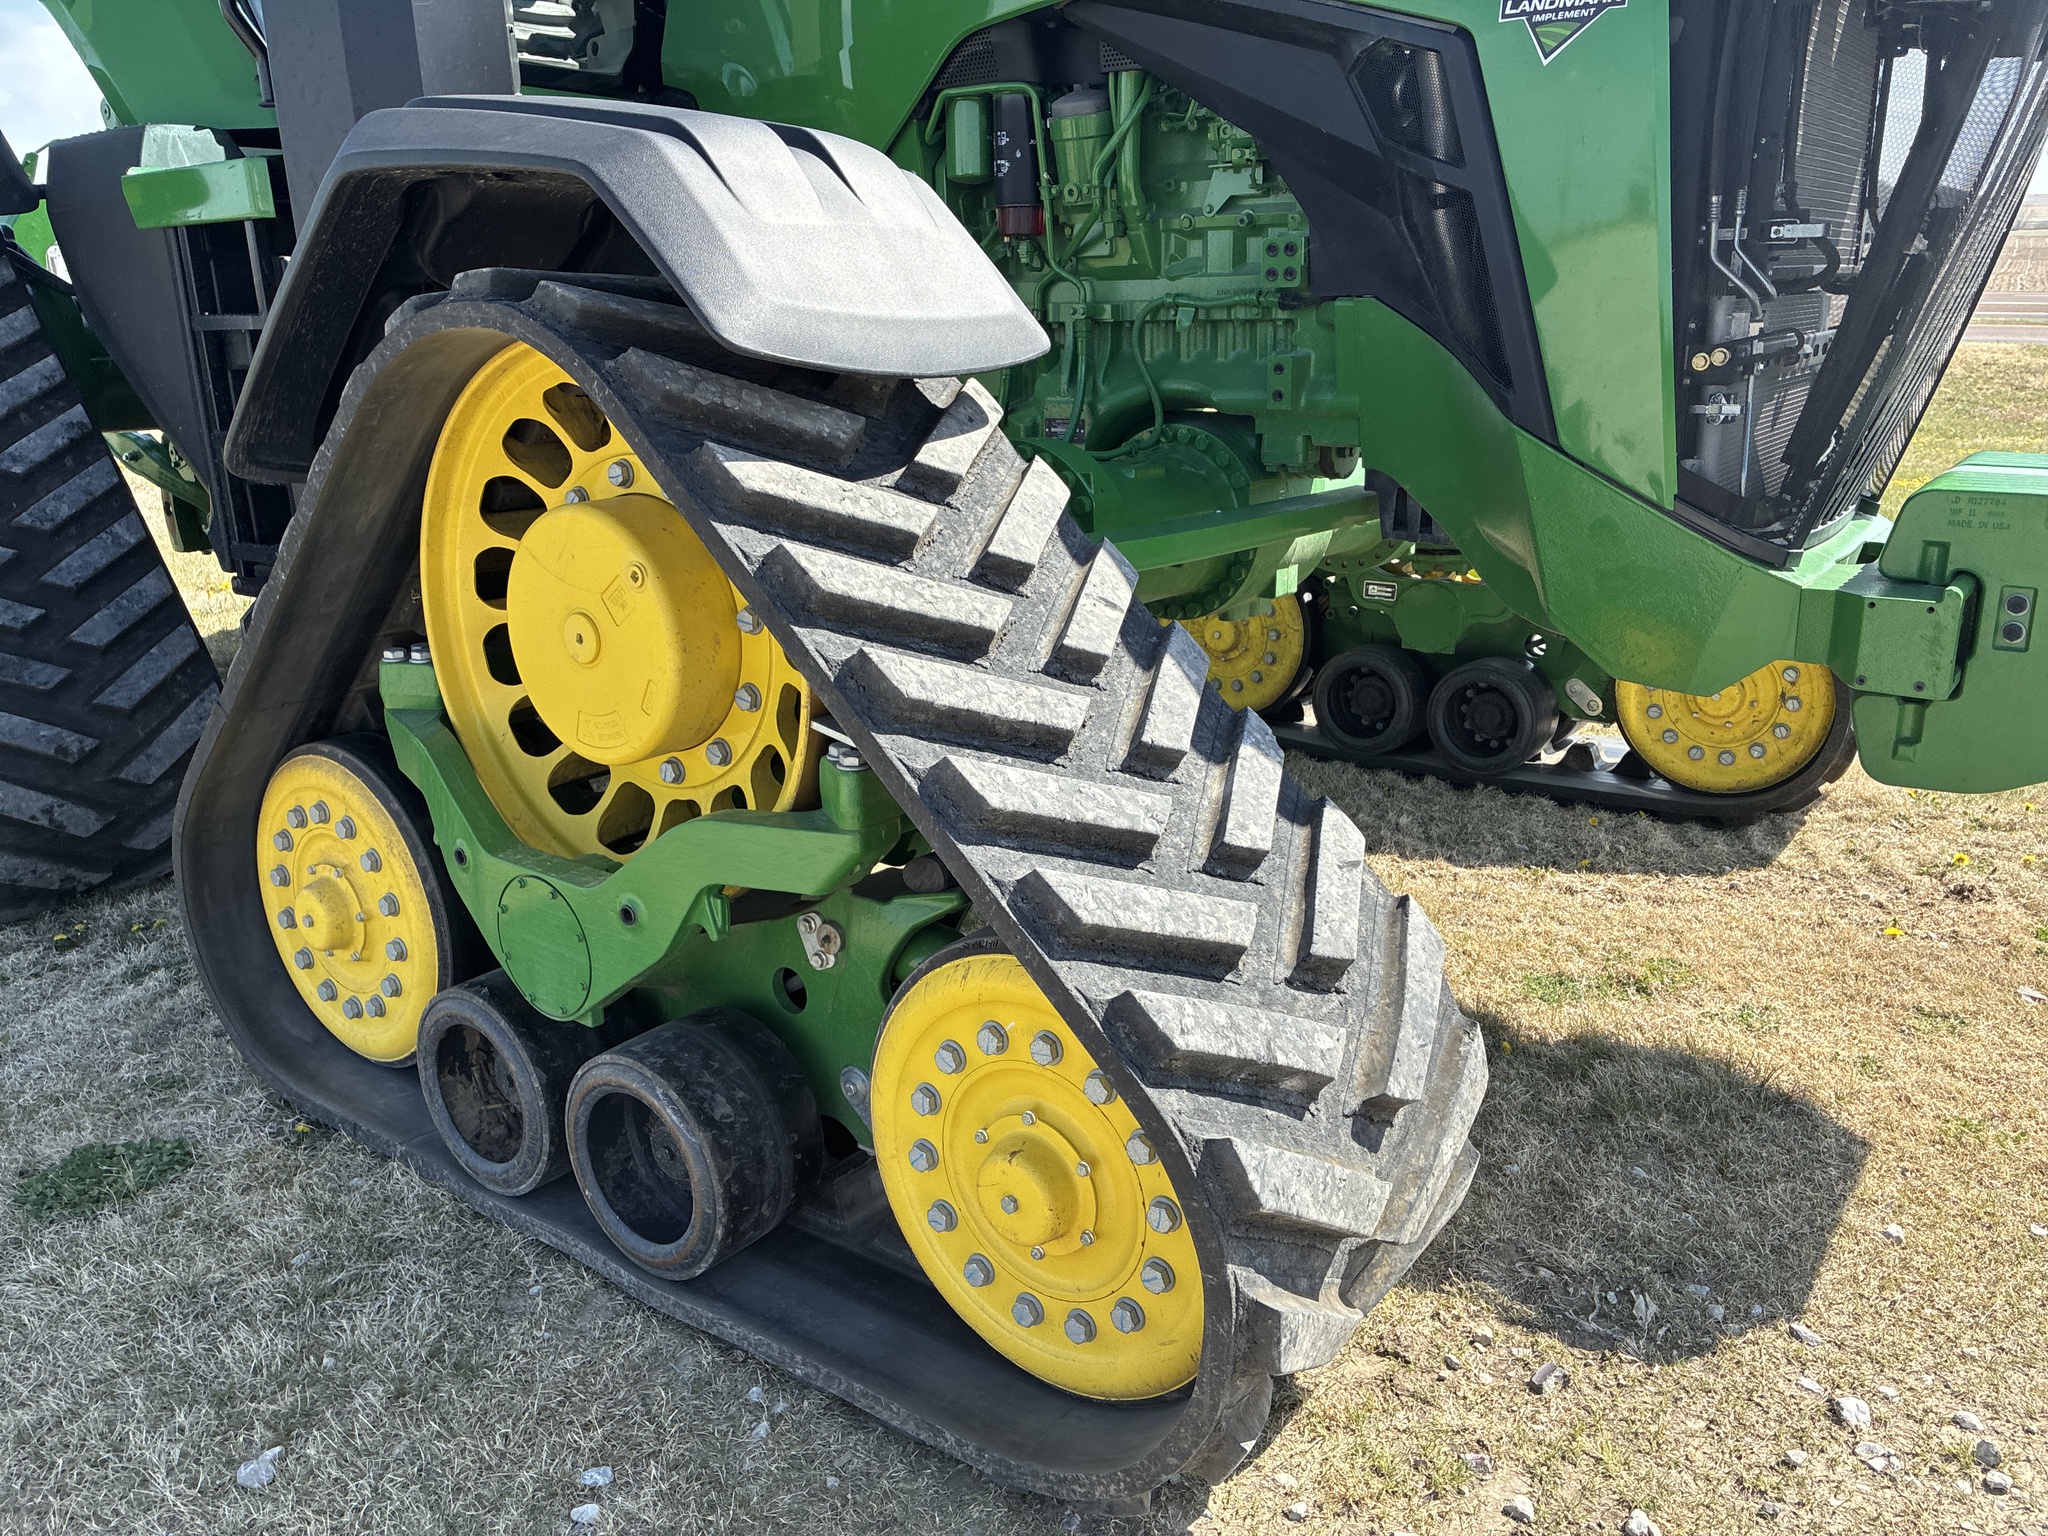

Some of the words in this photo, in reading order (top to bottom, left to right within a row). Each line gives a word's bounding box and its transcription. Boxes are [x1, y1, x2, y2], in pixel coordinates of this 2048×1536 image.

[1504, 0, 1621, 14] LANDM
[1532, 8, 1596, 22] IMPLEMENT
[1947, 519, 1973, 529] MADE
[1978, 521, 1988, 529] IN
[1992, 522, 2011, 530] USA
